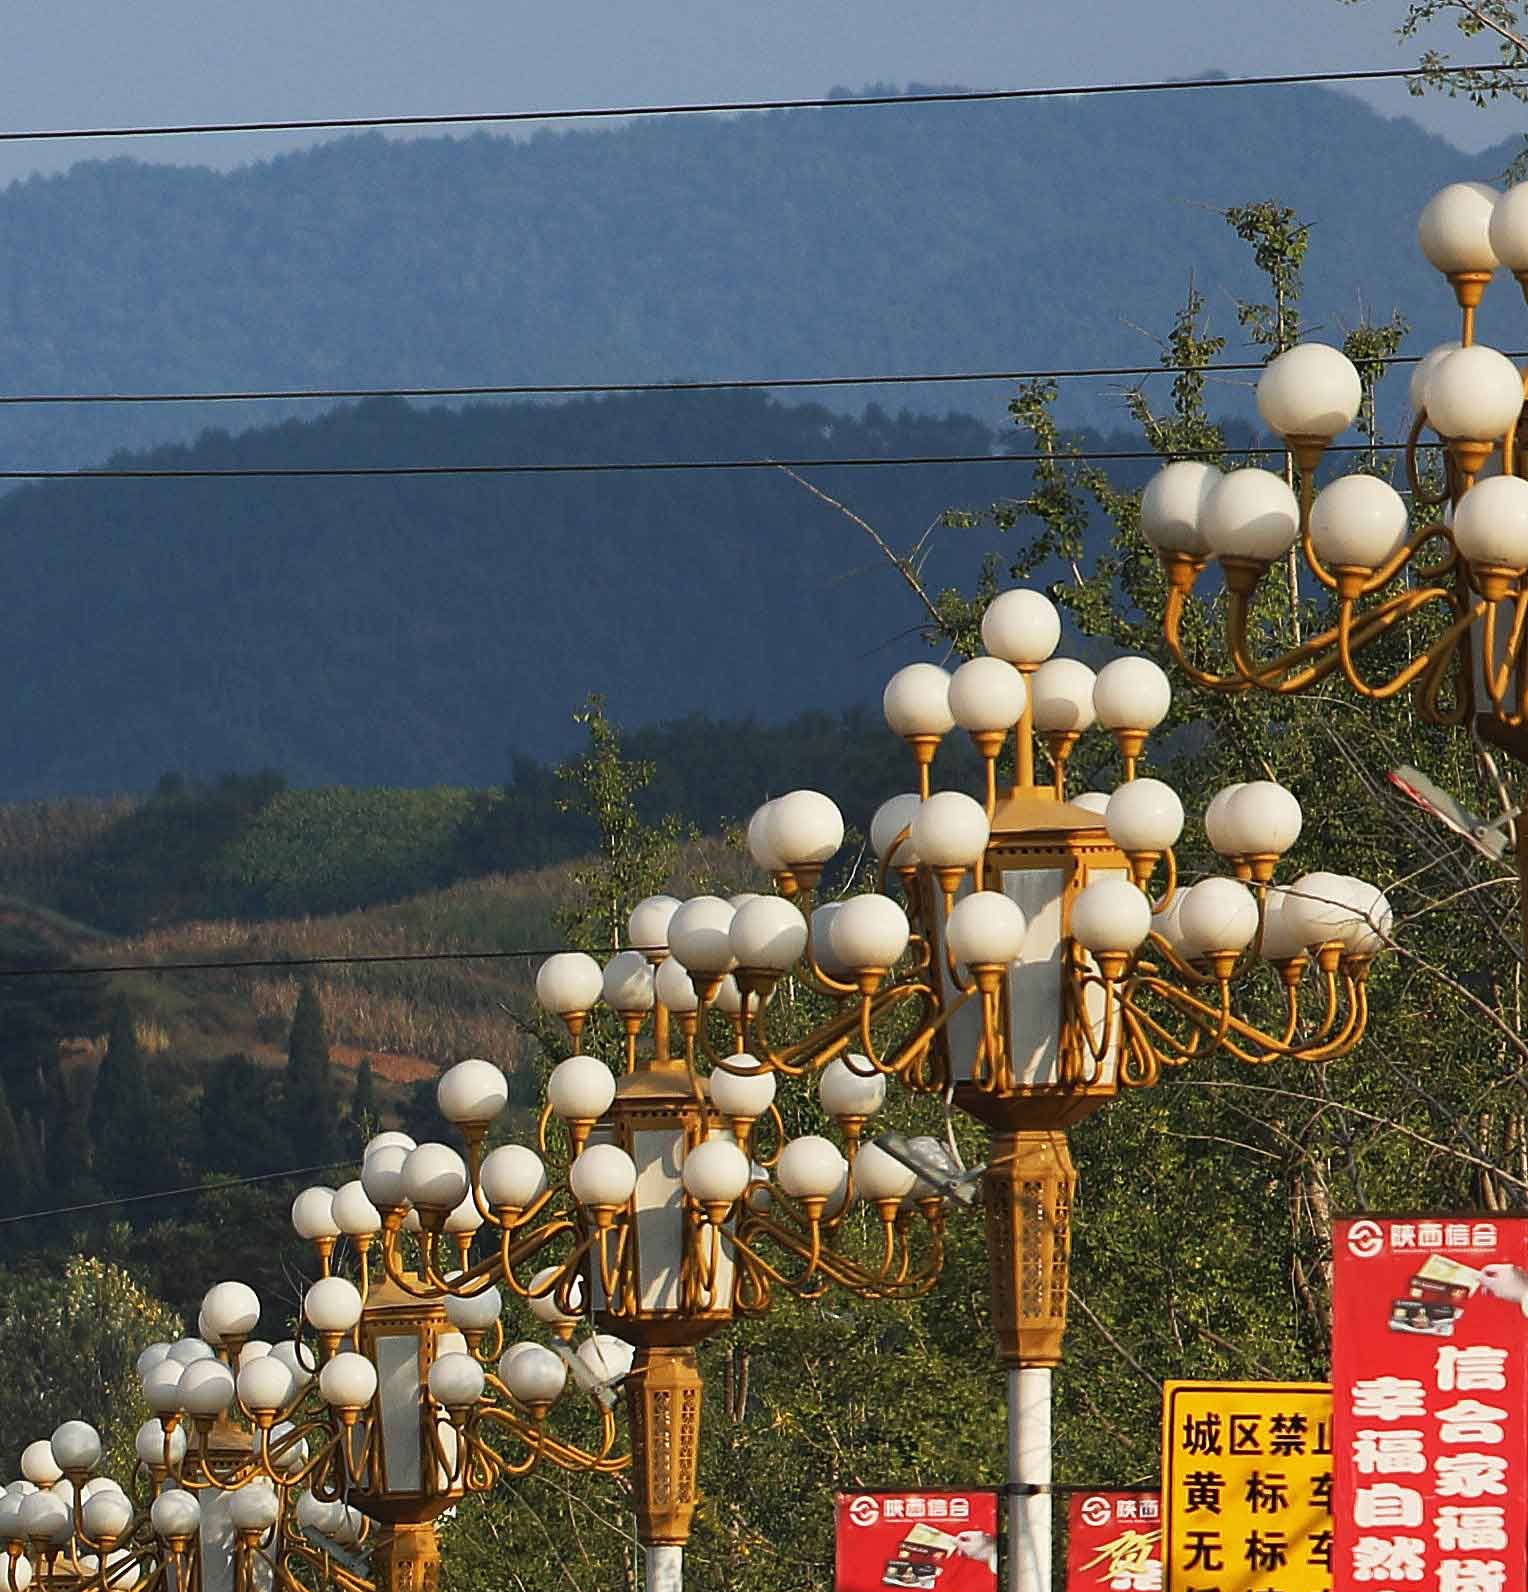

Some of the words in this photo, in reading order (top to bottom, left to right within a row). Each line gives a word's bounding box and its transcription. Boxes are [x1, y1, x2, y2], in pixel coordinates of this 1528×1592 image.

[1391, 1223, 1497, 1249] 陕西信合
[1182, 1412, 1334, 1456] 城区禁止
[883, 1497, 970, 1519] 陕西信合
